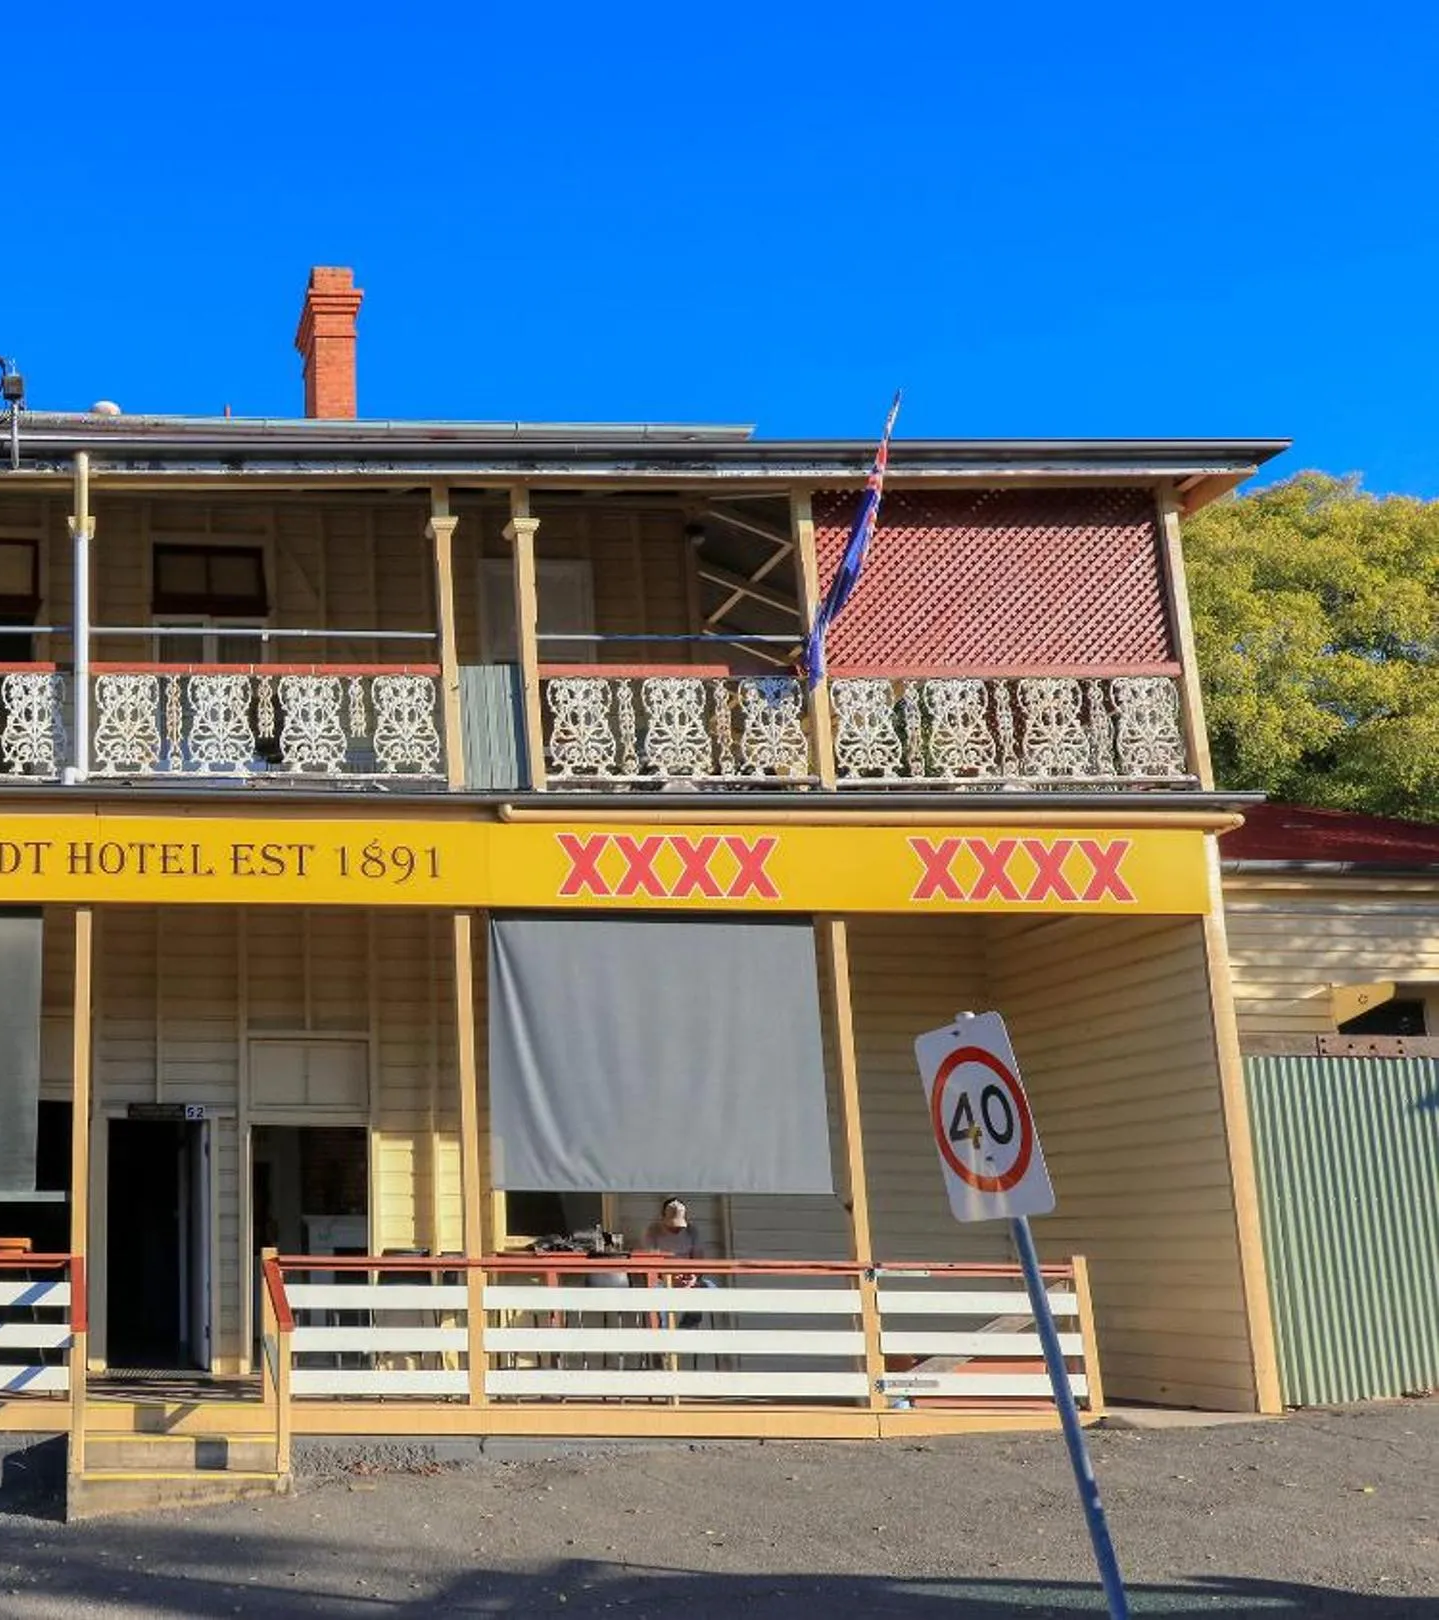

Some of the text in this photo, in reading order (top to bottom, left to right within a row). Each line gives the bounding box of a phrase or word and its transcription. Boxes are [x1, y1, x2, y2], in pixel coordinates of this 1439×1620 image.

[67, 841, 215, 877] HOTEL
[229, 843, 316, 877] EST
[334, 839, 441, 884] 1891
[555, 832, 780, 899] XXXX
[906, 836, 1139, 903] XXXX
[949, 1084, 1014, 1150] 40
